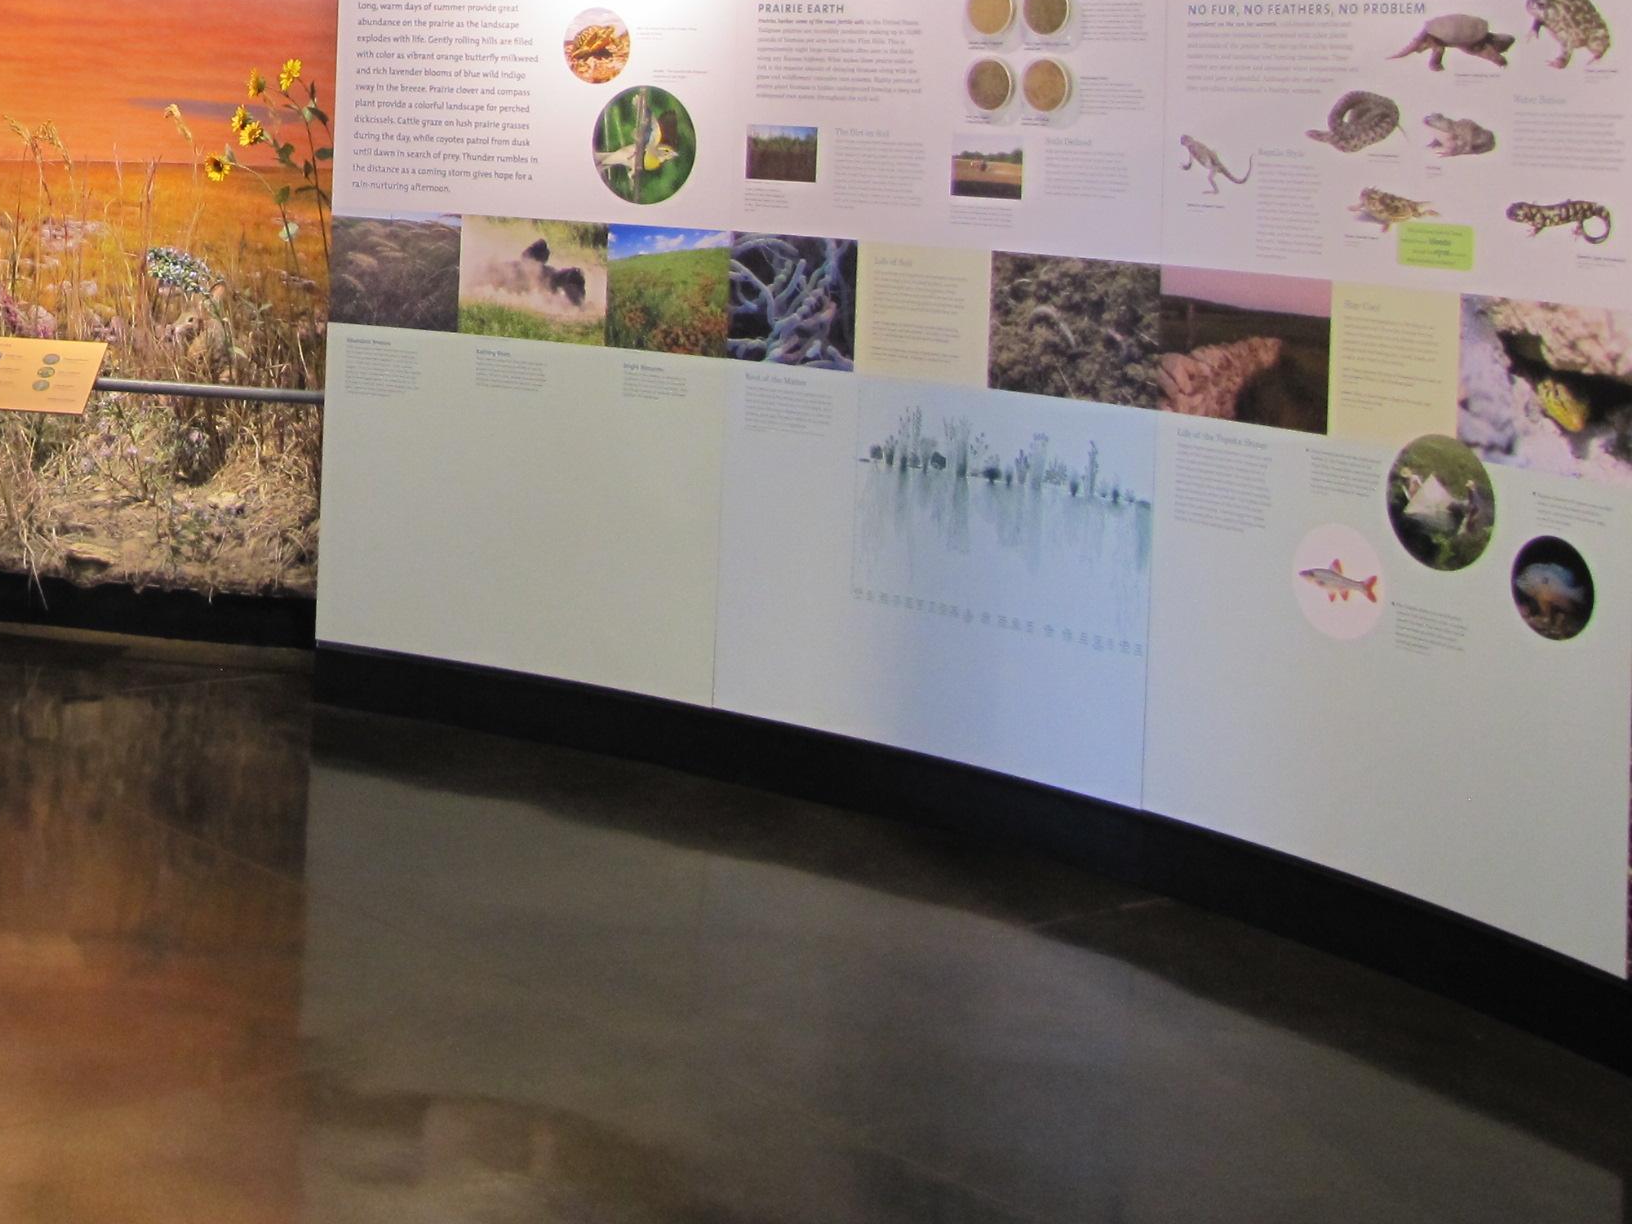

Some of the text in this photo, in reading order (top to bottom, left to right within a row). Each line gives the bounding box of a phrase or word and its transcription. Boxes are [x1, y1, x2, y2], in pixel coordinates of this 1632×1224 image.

[758, 4, 844, 13] PRAIRIE EARTH
[1188, 3, 1425, 17] NO FUR, NO FEATHERS, NO PROBLEM
